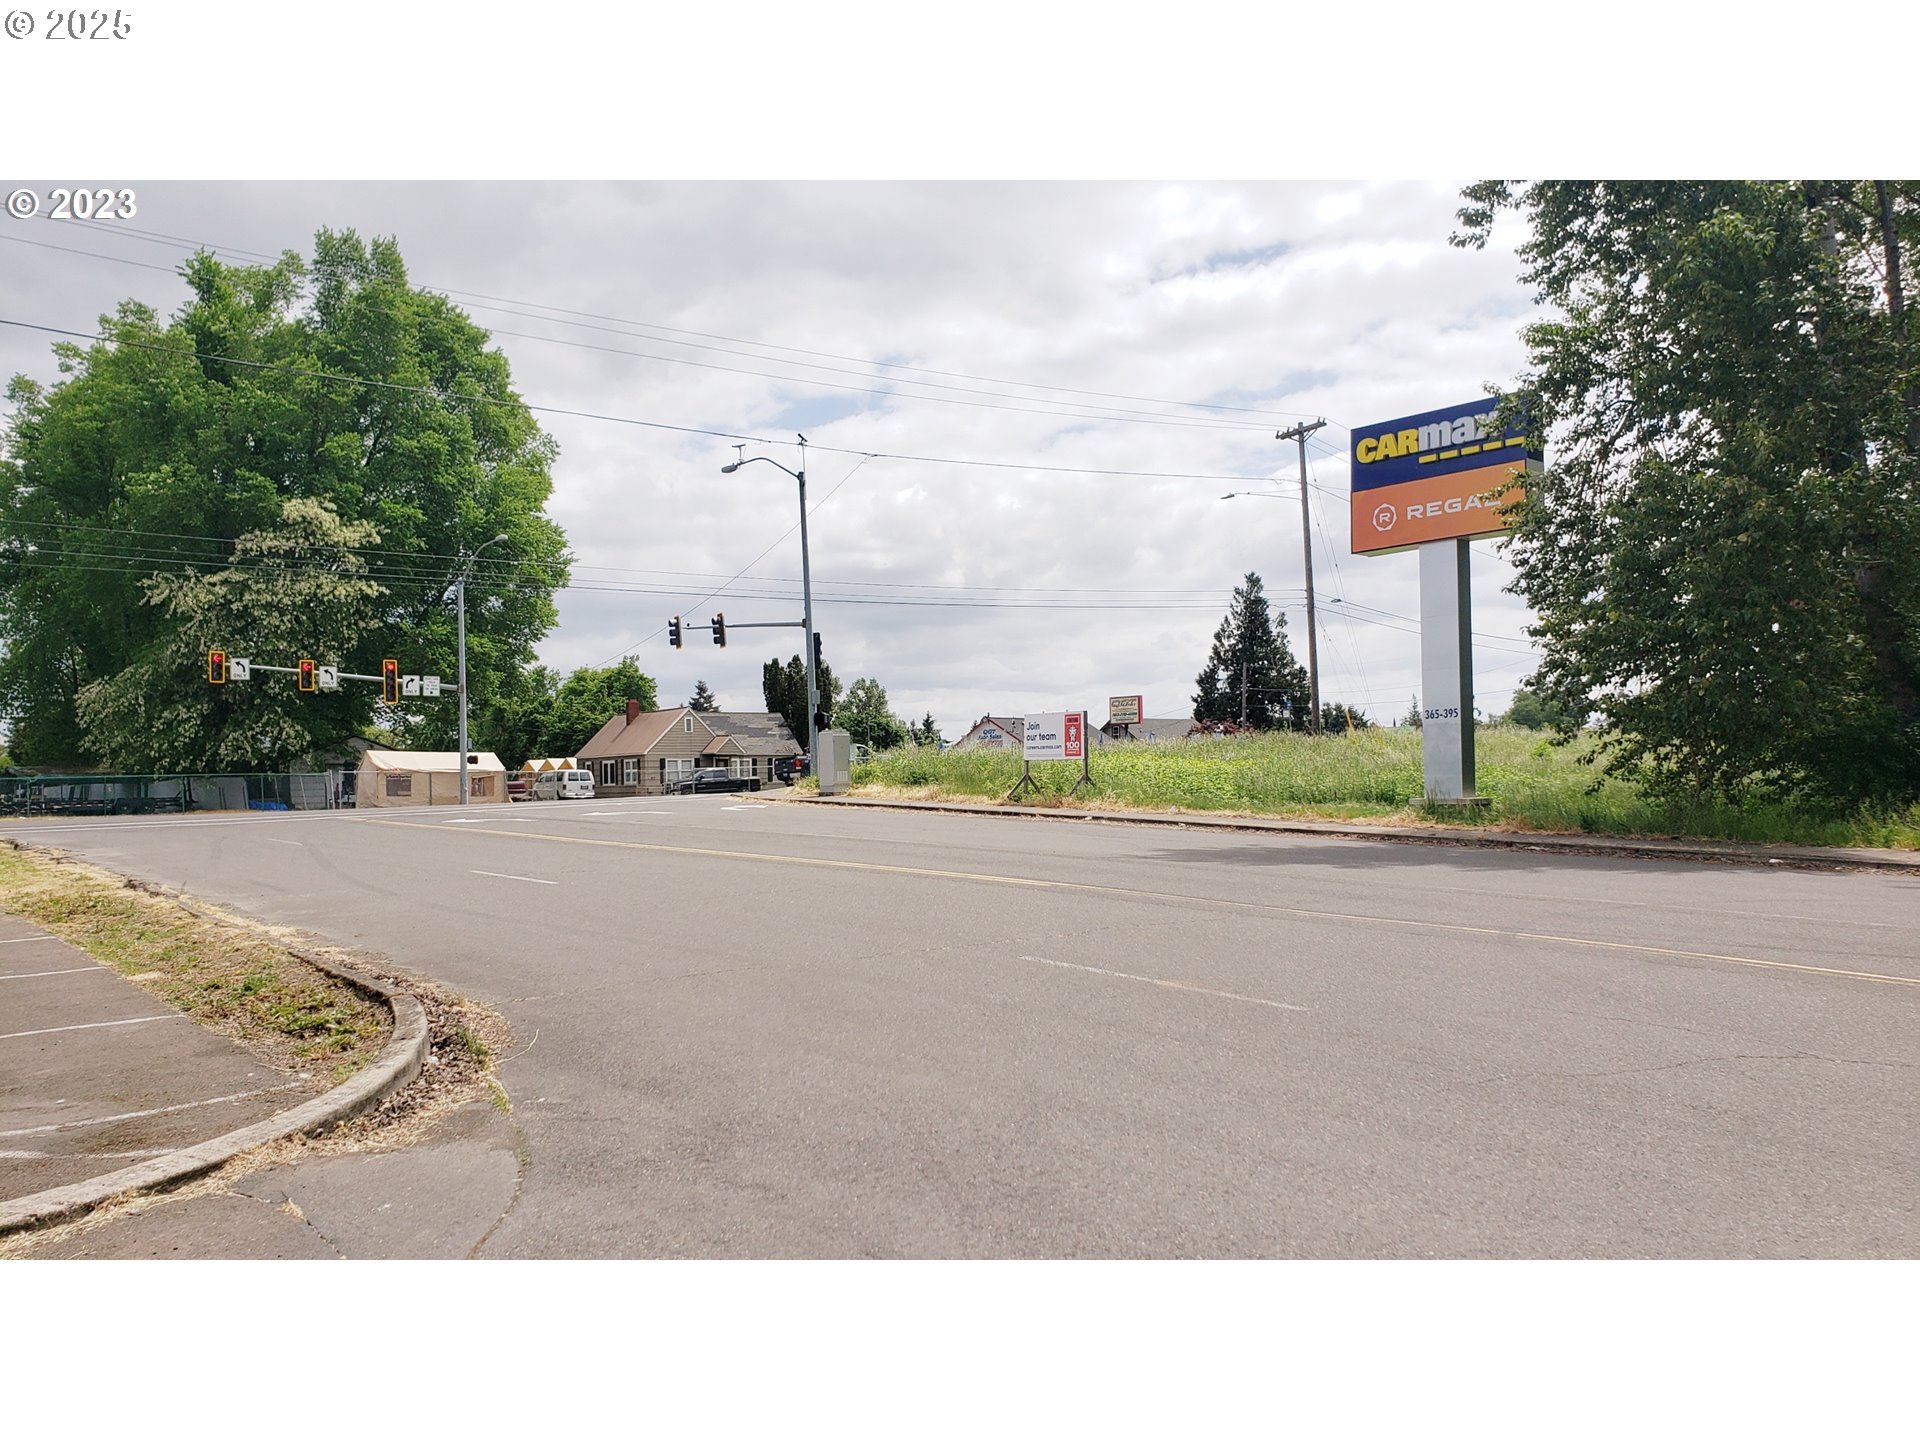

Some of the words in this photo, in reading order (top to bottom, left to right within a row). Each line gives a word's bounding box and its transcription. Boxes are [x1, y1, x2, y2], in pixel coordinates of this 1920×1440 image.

[1424, 708, 1459, 720] 365-395
[1026, 721, 1041, 731] Join
[1026, 734, 1038, 742] our
[1039, 732, 1057, 741] team
[1066, 741, 1080, 749] 100
